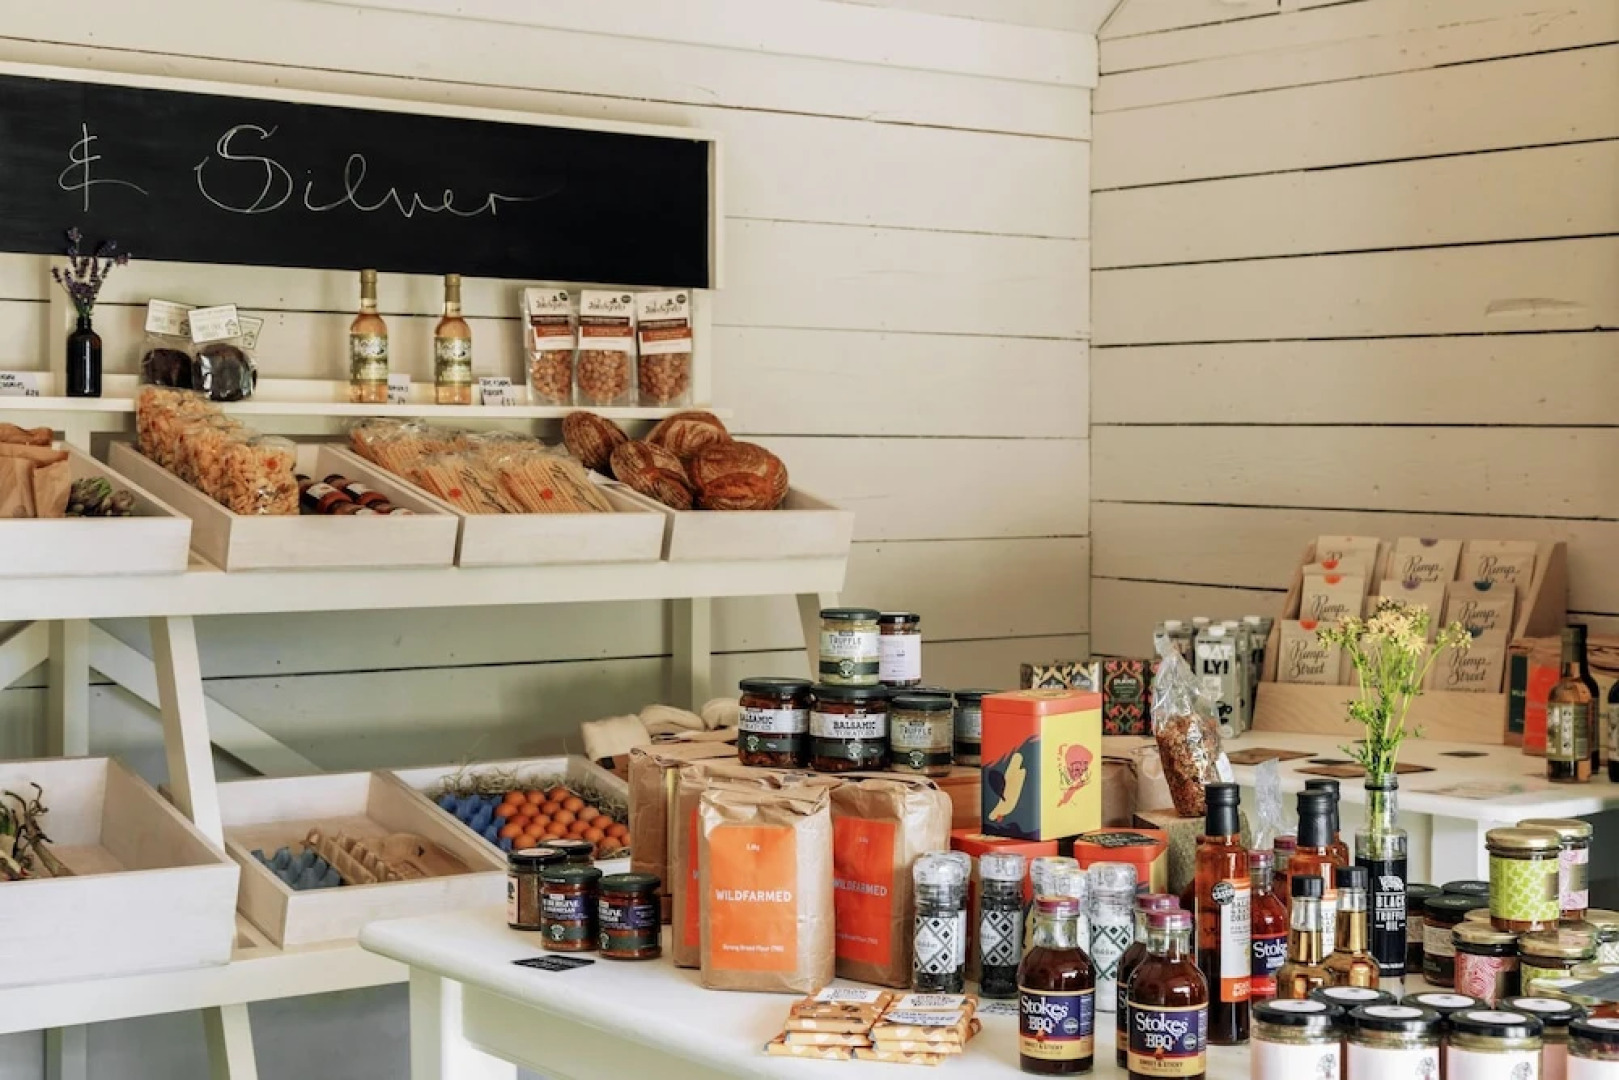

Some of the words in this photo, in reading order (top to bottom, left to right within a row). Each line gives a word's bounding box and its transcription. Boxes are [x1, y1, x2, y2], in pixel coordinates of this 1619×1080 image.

[58, 122, 148, 212] &
[193, 124, 555, 218] Silver
[833, 720, 876, 731] BALSAMIC
[715, 888, 793, 904] WILDFARMED
[1376, 894, 1406, 908] BLACK
[1021, 995, 1069, 1024] Stokes
[1028, 1016, 1053, 1034] BBQ
[1135, 1011, 1188, 1040] Stokes
[1145, 1033, 1173, 1051] BBQ
